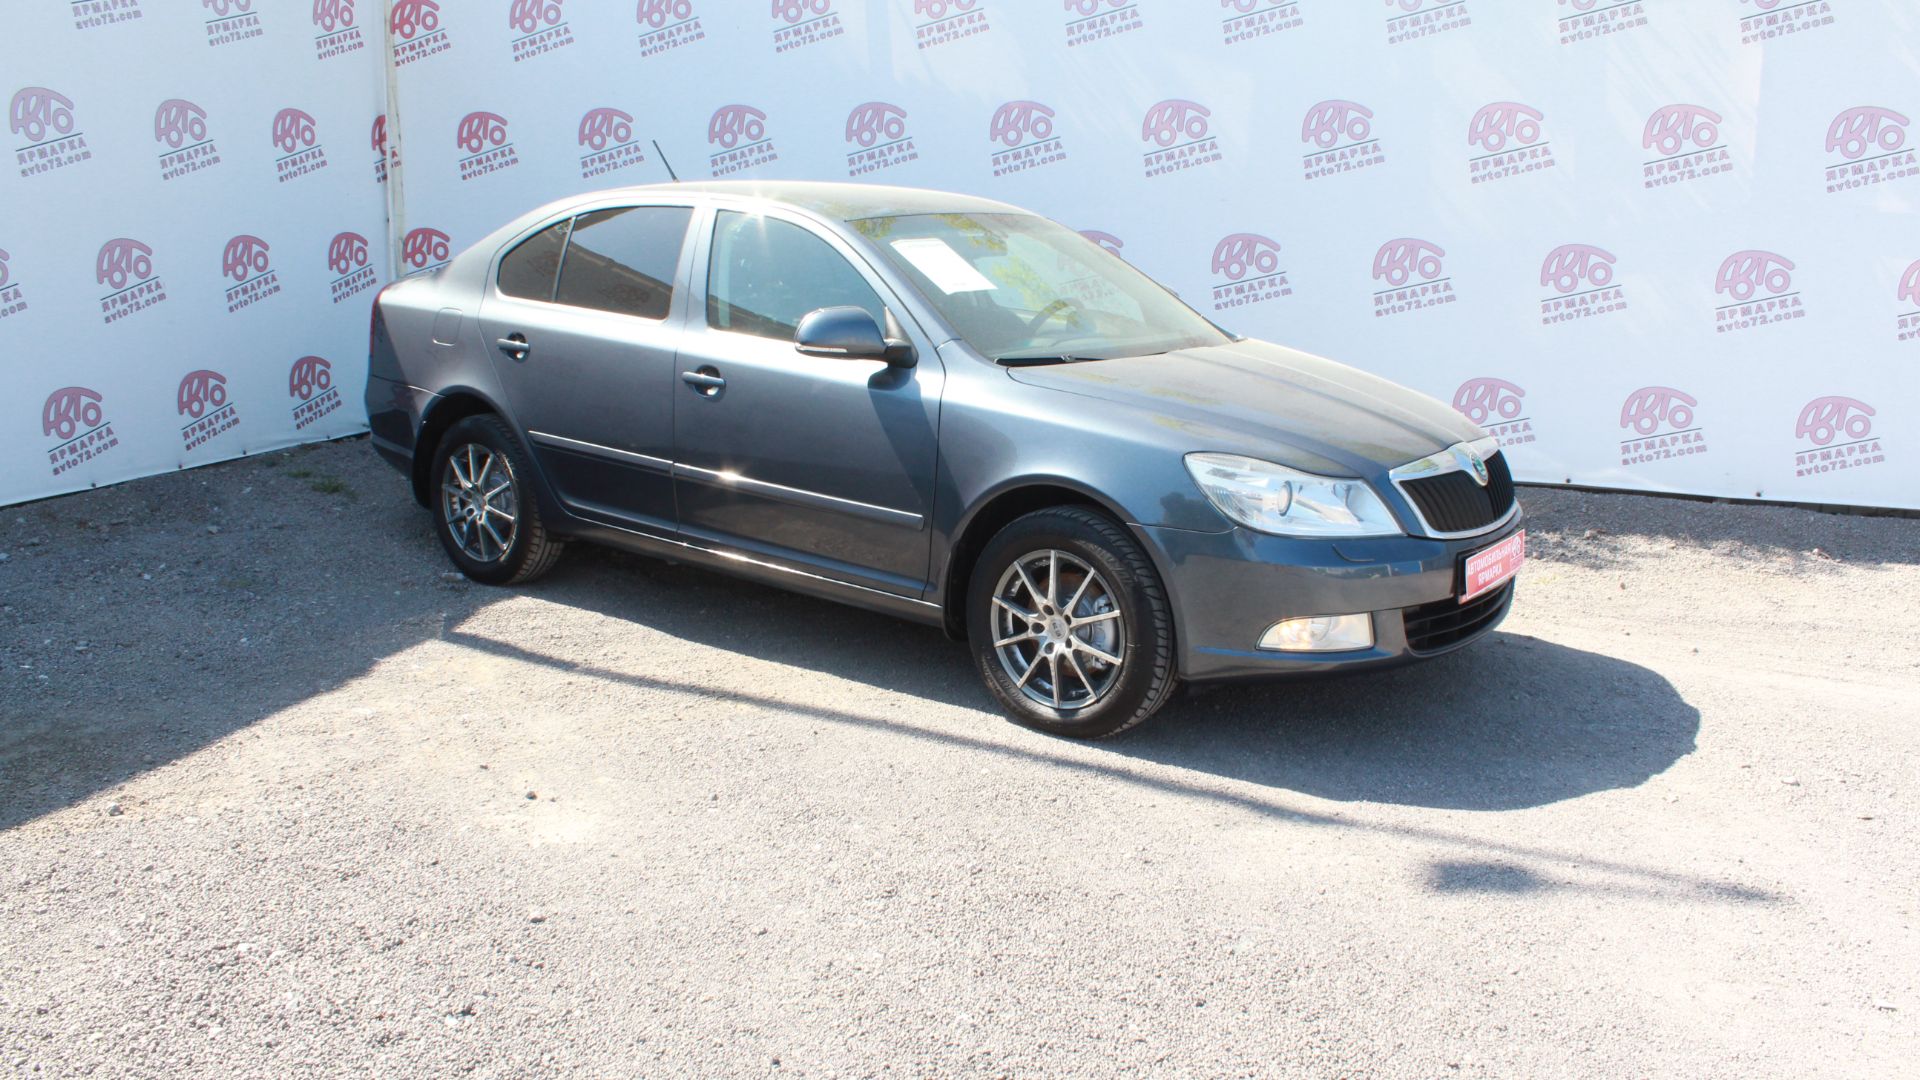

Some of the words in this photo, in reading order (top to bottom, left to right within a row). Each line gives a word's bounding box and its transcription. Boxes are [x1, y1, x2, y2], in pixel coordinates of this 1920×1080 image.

[75, 10, 143, 30] avto72.com
[206, 15, 260, 36] ЯРМАРКА
[774, 16, 840, 44] ЯРМАРКА
[916, 12, 986, 39] ЯРМАРКА
[1066, 8, 1140, 37] ЯРМАРКА
[1222, 6, 1300, 34] ЯРМАРКА
[1387, 4, 1468, 34] ЯРМАРКА
[1388, 17, 1472, 44] avto72.com
[1558, 3, 1644, 33] ЯРМАРКА
[1560, 16, 1648, 45] avto72.com
[1740, 1, 1831, 33] ЯРМАРКА
[1742, 15, 1835, 45] avto72.com
[208, 28, 264, 47] avto72.com
[315, 30, 361, 50] ЯРМАРКА
[512, 26, 571, 53] ЯРМАРКА
[639, 20, 702, 48] ЯРМАРКА
[641, 31, 705, 58] avto72.com
[775, 27, 844, 53] avto72.com
[918, 23, 990, 50] avto72.com
[1067, 20, 1143, 47] avto72.com
[1224, 17, 1304, 45] avto72.com
[317, 41, 364, 60] avto72.com
[394, 32, 448, 58] ЯРМАРКА
[395, 42, 451, 67] avto72.com
[514, 36, 575, 63] avto72.com
[17, 137, 87, 166] ЯРМАРКА
[20, 150, 92, 178] avto72.com
[160, 143, 217, 170] ЯРМАРКА
[276, 148, 325, 173] ЯРМАРКА
[459, 146, 516, 172] ЯРМАРКА
[581, 144, 641, 170] ЯРМАРКА
[710, 142, 775, 168] ЯРМАРКА
[712, 152, 779, 178] avto72.com
[847, 141, 915, 167] ЯРМАРКА
[848, 152, 919, 177] avto72.com
[992, 140, 1063, 167] ЯРМАРКА
[993, 152, 1067, 177] avto72.com
[1144, 140, 1219, 168] ЯРМАРКА
[1145, 152, 1223, 178] avto72.com
[1303, 142, 1382, 169] ЯРМАРКА
[1469, 146, 1552, 174] ЯРМАРКА
[1643, 149, 1730, 178] ЯРМАРКА
[162, 155, 221, 181] avto72.com
[278, 159, 328, 183] avto72.com
[461, 157, 519, 181] avto72.com
[582, 154, 645, 179] avto72.com
[1304, 155, 1386, 180] avto72.com
[1471, 158, 1555, 184] avto72.com
[1644, 162, 1733, 189] avto72.com
[1825, 152, 1917, 182] ЯРМАРКА
[1826, 166, 1920, 194] avto72.com
[226, 273, 278, 303] ЯРМАРКА
[331, 267, 375, 295] ЯРМАРКА
[333, 277, 377, 304] avto72.com
[1213, 275, 1289, 301] ЯРМАРКА
[1374, 281, 1453, 307] ЯРМАРКА
[101, 280, 163, 313] ЯРМАРКА
[104, 292, 167, 324] avto72.com
[228, 284, 281, 313] avto72.com
[1214, 287, 1293, 311] avto72.com
[1375, 294, 1457, 318] avto72.com
[1541, 288, 1624, 314] ЯРМАРКА
[1716, 296, 1803, 322] ЯРМАРКА
[1542, 301, 1627, 325] avto72.com
[1716, 309, 1806, 333] avto72.com
[293, 390, 339, 421] ЯРМАРКА
[296, 400, 341, 430] avto72.com
[182, 406, 236, 441] ЯРМАРКА
[185, 417, 240, 451] avto72.com
[1489, 422, 1532, 437] АРКА
[49, 426, 114, 465] ЯРМАРКА
[52, 437, 119, 476] avto72.com
[1620, 432, 1704, 455] ЯРМАРКА
[1621, 444, 1708, 466] avto72.com
[1795, 441, 1882, 466] ЯРМАРКА
[1796, 454, 1885, 477] avto72.com
